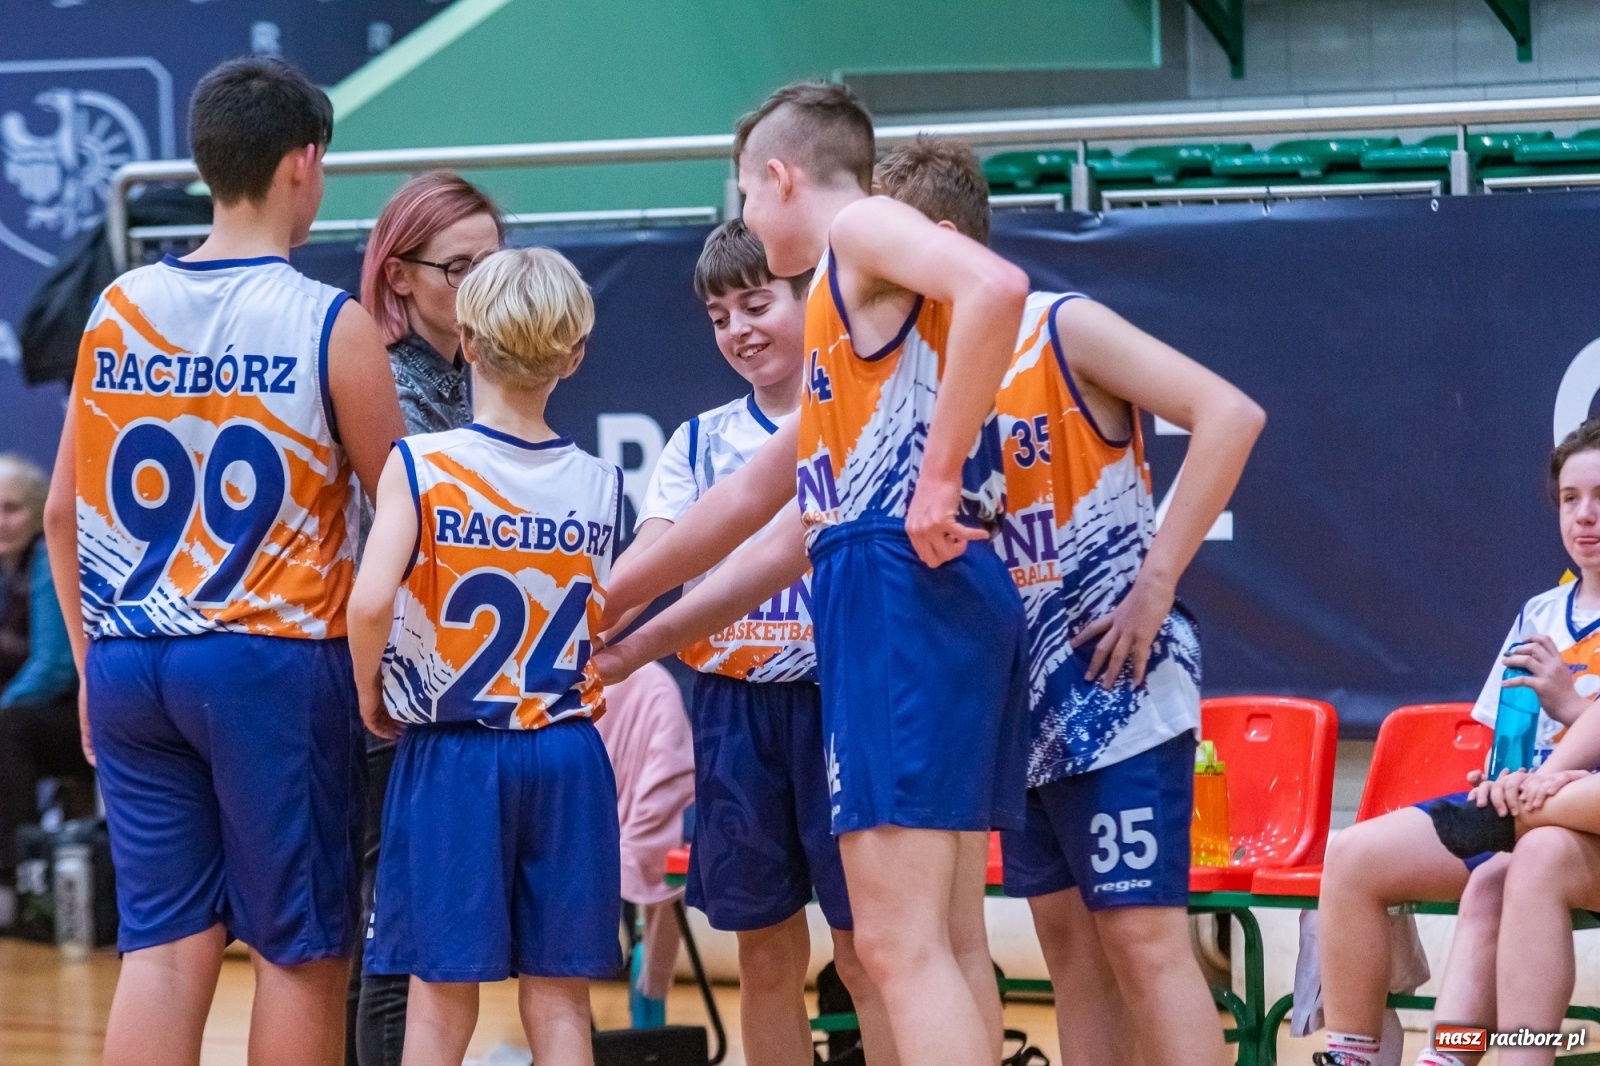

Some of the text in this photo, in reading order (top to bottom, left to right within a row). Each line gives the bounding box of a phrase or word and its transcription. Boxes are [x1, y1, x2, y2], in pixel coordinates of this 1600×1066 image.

[94, 344, 298, 395] RACIBÓRZ
[1010, 414, 1051, 468] 35
[109, 420, 289, 605] 99
[1003, 509, 1059, 568] NI
[436, 571, 592, 729] 24
[713, 621, 815, 643] BASKETBA
[1089, 806, 1158, 873] 35
[1093, 879, 1153, 893] regio
